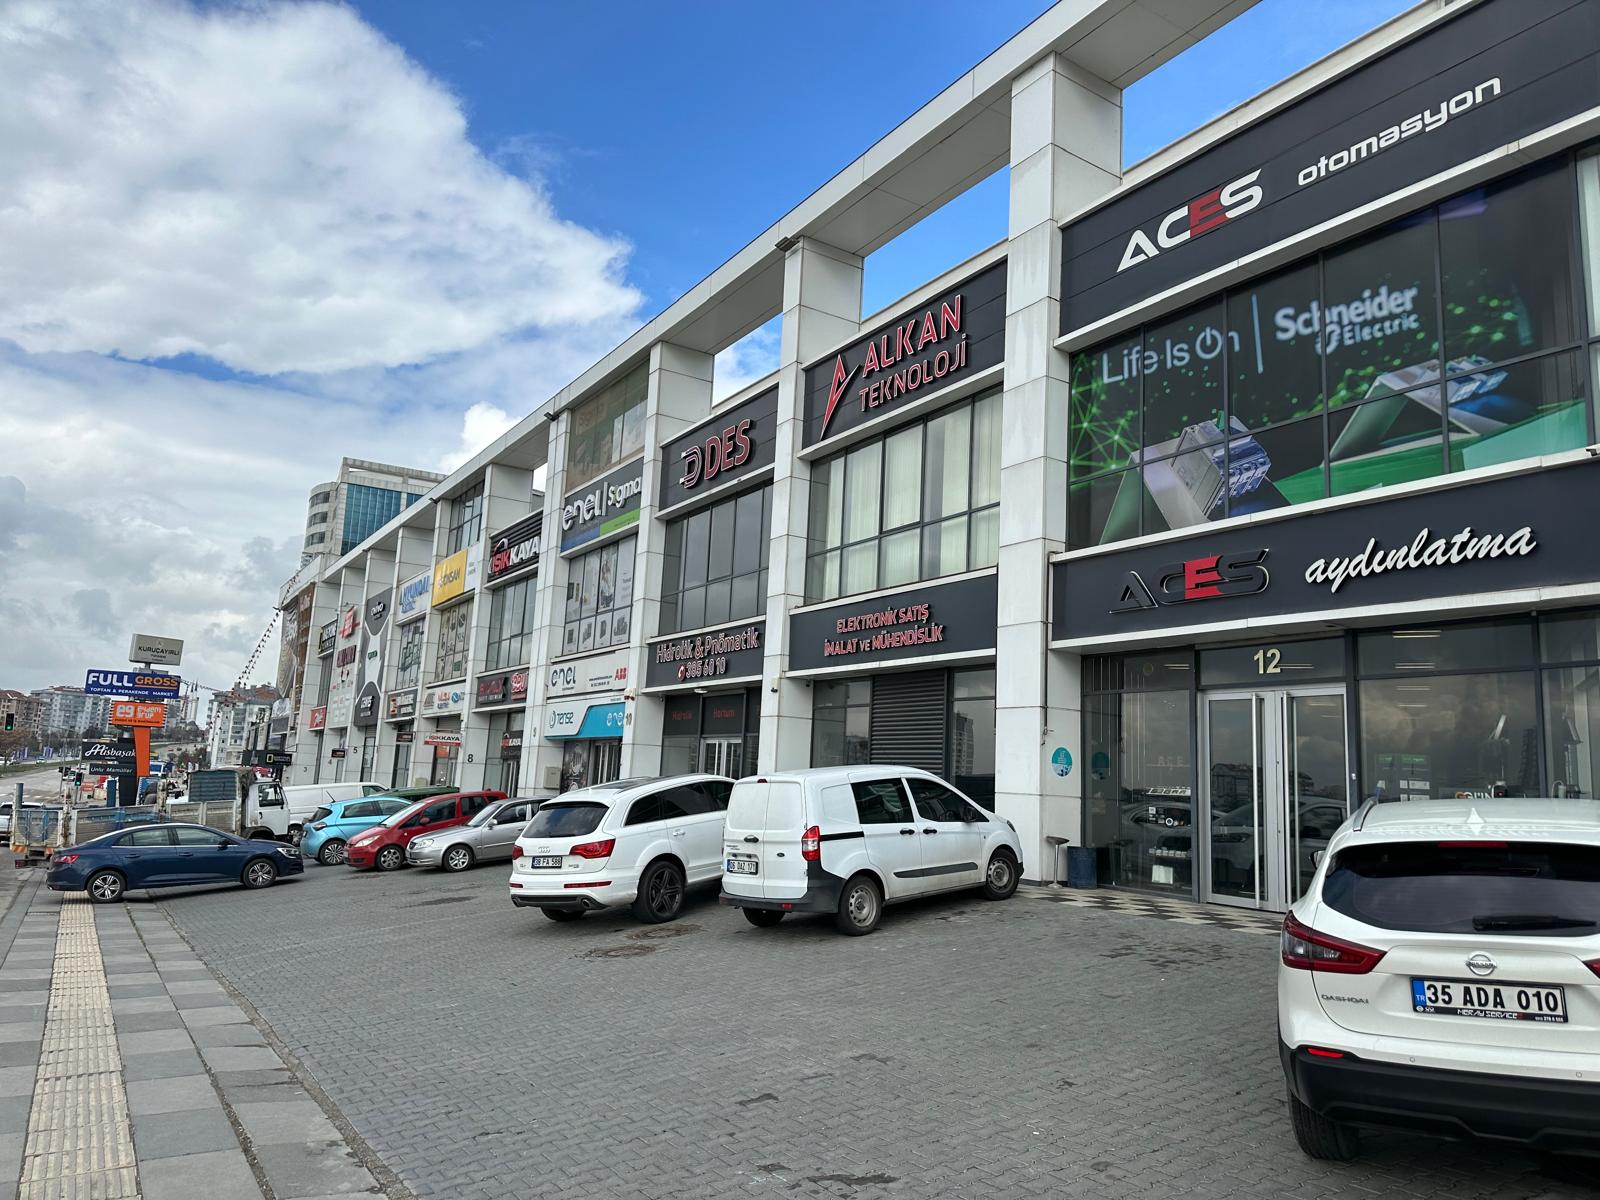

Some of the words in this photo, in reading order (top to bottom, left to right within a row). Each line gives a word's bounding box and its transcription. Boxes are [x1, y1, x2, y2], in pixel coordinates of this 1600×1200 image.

[1116, 168, 1264, 273] ACES
[1297, 77, 1502, 186] otomasyon
[1274, 285, 1419, 341] Schneider
[862, 294, 962, 378] ALKAN
[1342, 313, 1420, 346] Electric
[1102, 345, 1159, 384] Life
[1165, 339, 1191, 369] Is
[562, 489, 602, 531] enel
[1305, 527, 1537, 594] aydınlatma
[1108, 547, 1270, 615] ACES
[836, 606, 898, 633] ELEKTRONİK
[898, 603, 929, 623] SATIŞ
[656, 640, 693, 664] Hidrolik
[694, 637, 704, 660] &
[704, 626, 760, 657] Pnömatik
[823, 638, 859, 657] İMALAT
[871, 623, 944, 650] MÜHENDİSLİK
[551, 666, 577, 688] enel
[614, 667, 627, 681] ABB
[685, 660, 703, 679] 385
[715, 656, 726, 674] 10
[1252, 648, 1282, 675] 12
[87, 672, 133, 687] FULL
[134, 675, 178, 687] GROSS
[606, 711, 625, 727] ene
[353, 746, 358, 754] 5
[467, 753, 474, 763] 8
[1416, 994, 1425, 1002] TR
[1426, 983, 1453, 1005] 35
[1462, 985, 1506, 1009] ADA
[1516, 989, 1559, 1013] 010
